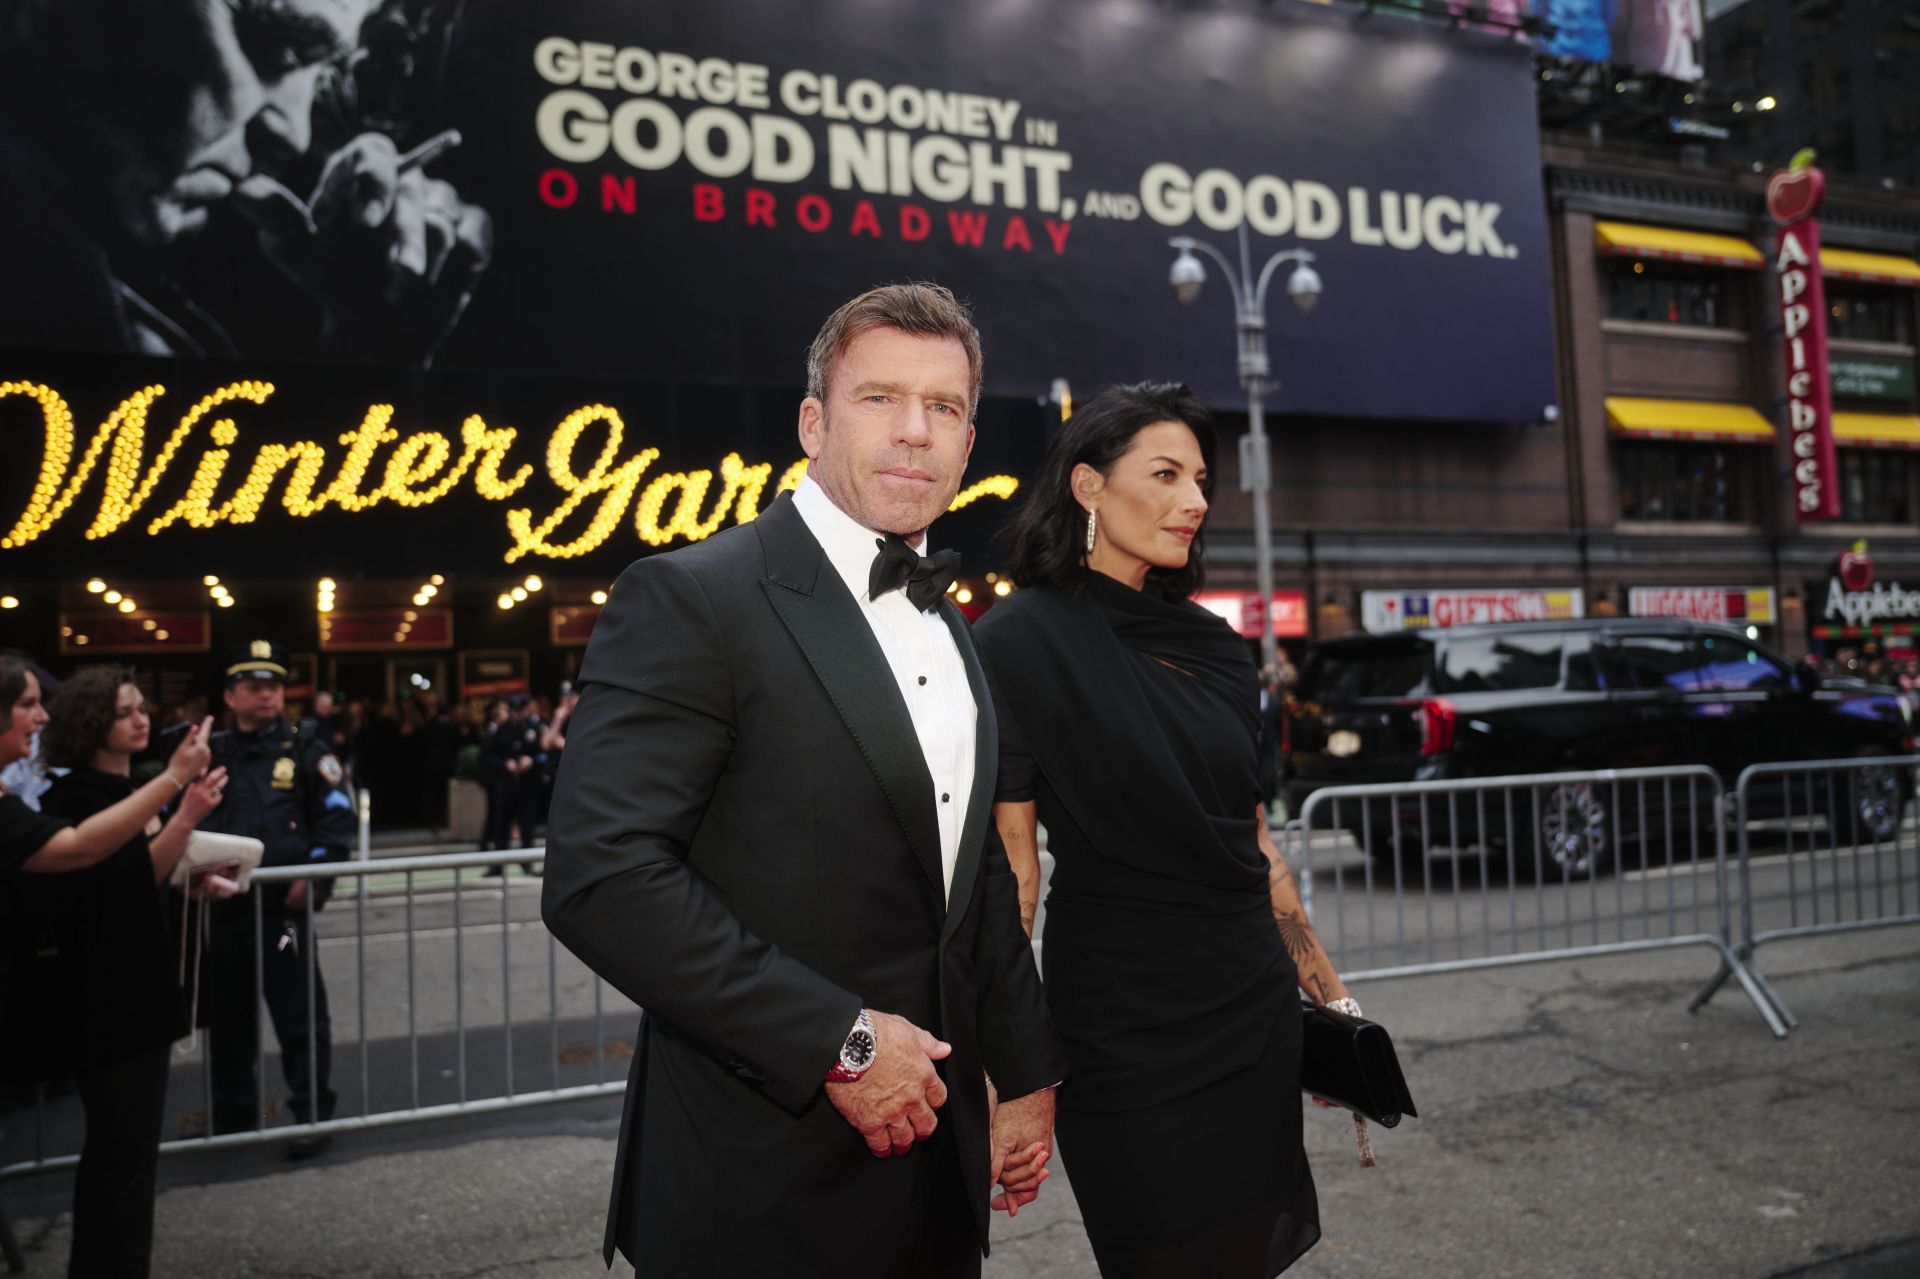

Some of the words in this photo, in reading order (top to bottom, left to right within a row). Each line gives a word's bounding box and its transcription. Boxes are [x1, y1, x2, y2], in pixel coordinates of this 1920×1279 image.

[534, 36, 770, 109] GEORGE
[780, 69, 1021, 141] CLOONEY
[1025, 117, 1058, 147] IN
[535, 89, 815, 183] GOOD
[828, 124, 1076, 219] NIGHT,
[1083, 190, 1141, 222] AND
[1139, 162, 1341, 240] GOOD
[1348, 187, 1518, 259] LUCK.
[538, 169, 637, 214] ON
[693, 184, 1073, 254] BROADWAY
[0, 380, 533, 549] Winter
